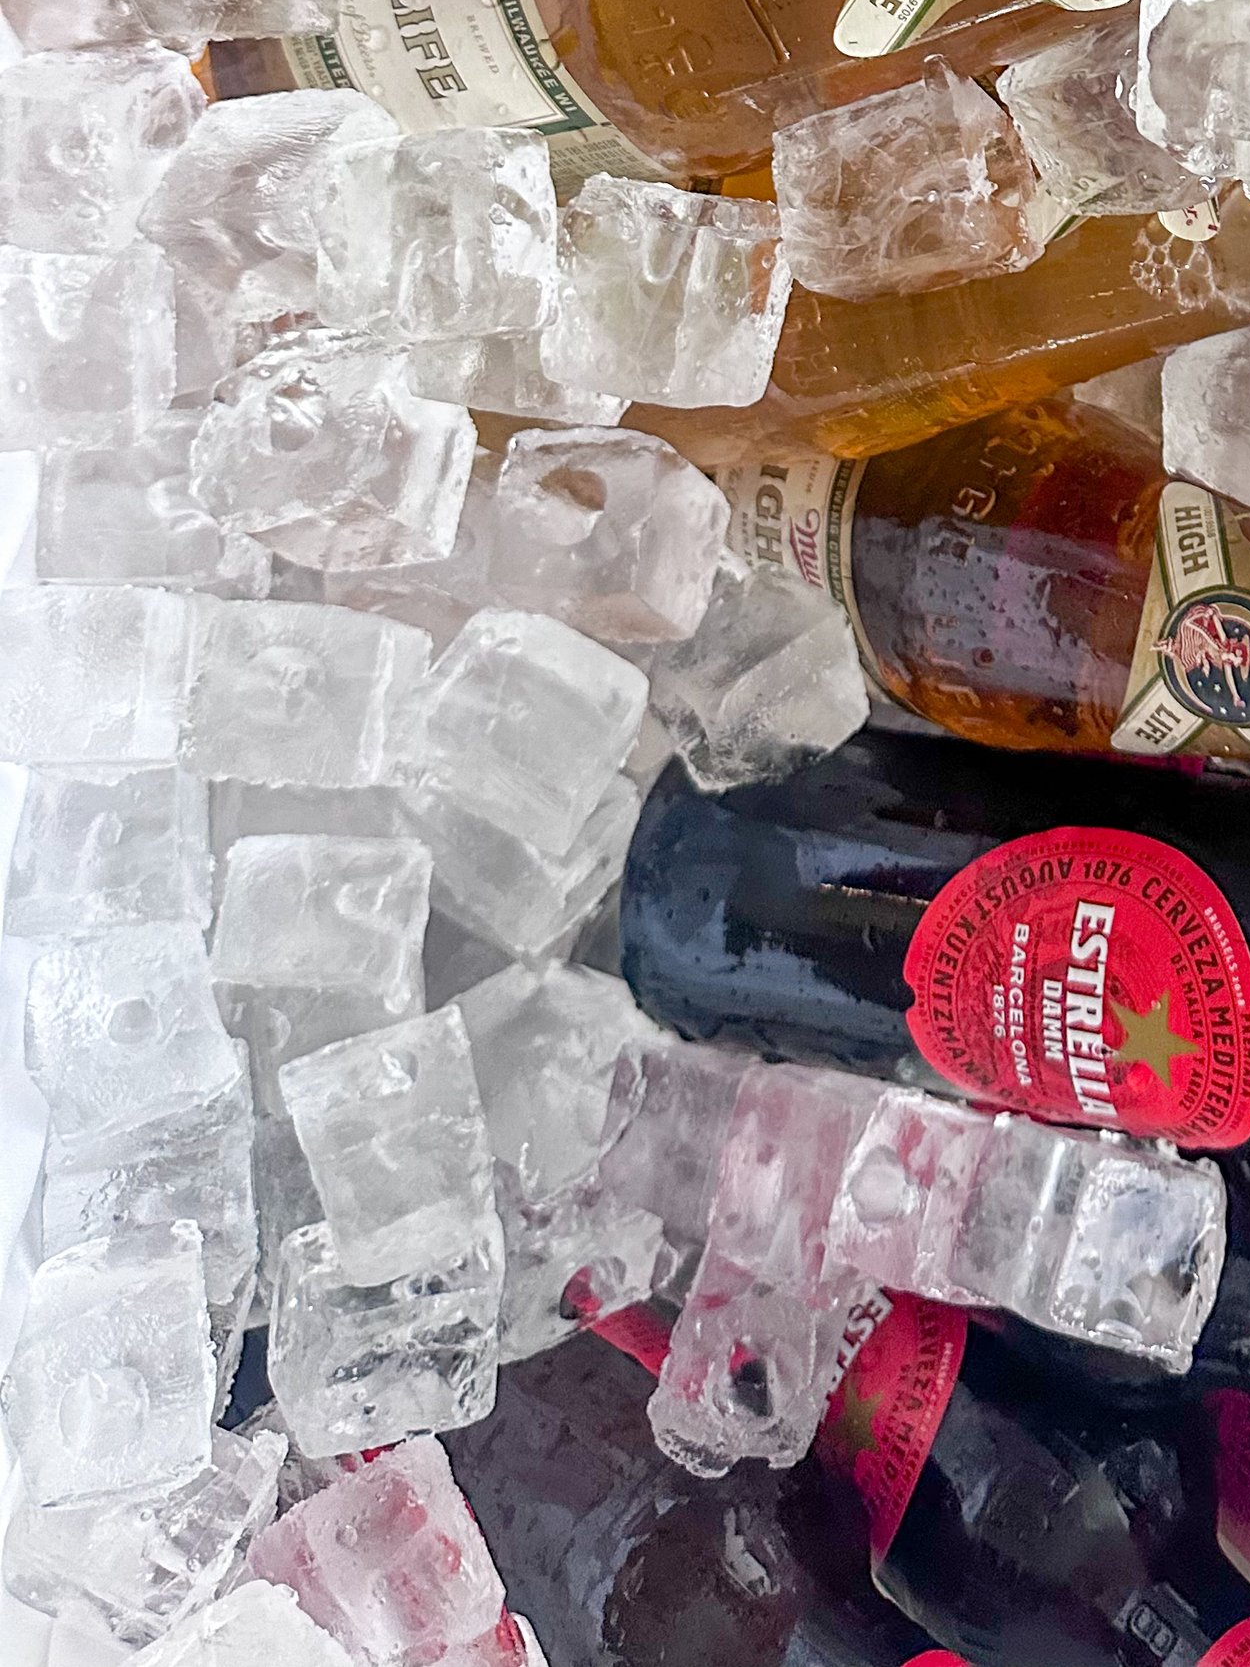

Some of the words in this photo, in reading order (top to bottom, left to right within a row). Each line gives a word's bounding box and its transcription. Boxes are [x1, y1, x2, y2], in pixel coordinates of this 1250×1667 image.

[465, 15, 500, 75] BREWED
[557, 97, 577, 114] WI
[755, 463, 789, 565] IGH
[1174, 505, 1211, 577] HIGH
[1135, 702, 1182, 746] LIFE
[974, 856, 1074, 921] AUGUST
[1082, 859, 1133, 886] 1876
[1141, 877, 1218, 997] CERVEZA
[1202, 906, 1239, 975] BRUSSELS
[1170, 952, 1186, 977] DE
[992, 983, 1007, 1039] 1876
[1010, 922, 1033, 1086] BARCELONA
[1041, 978, 1065, 1061] DAMM
[1066, 898, 1119, 1117] ESTRELLA
[1182, 984, 1205, 1041] MALTA
[1177, 1069, 1205, 1112] ARROZ
